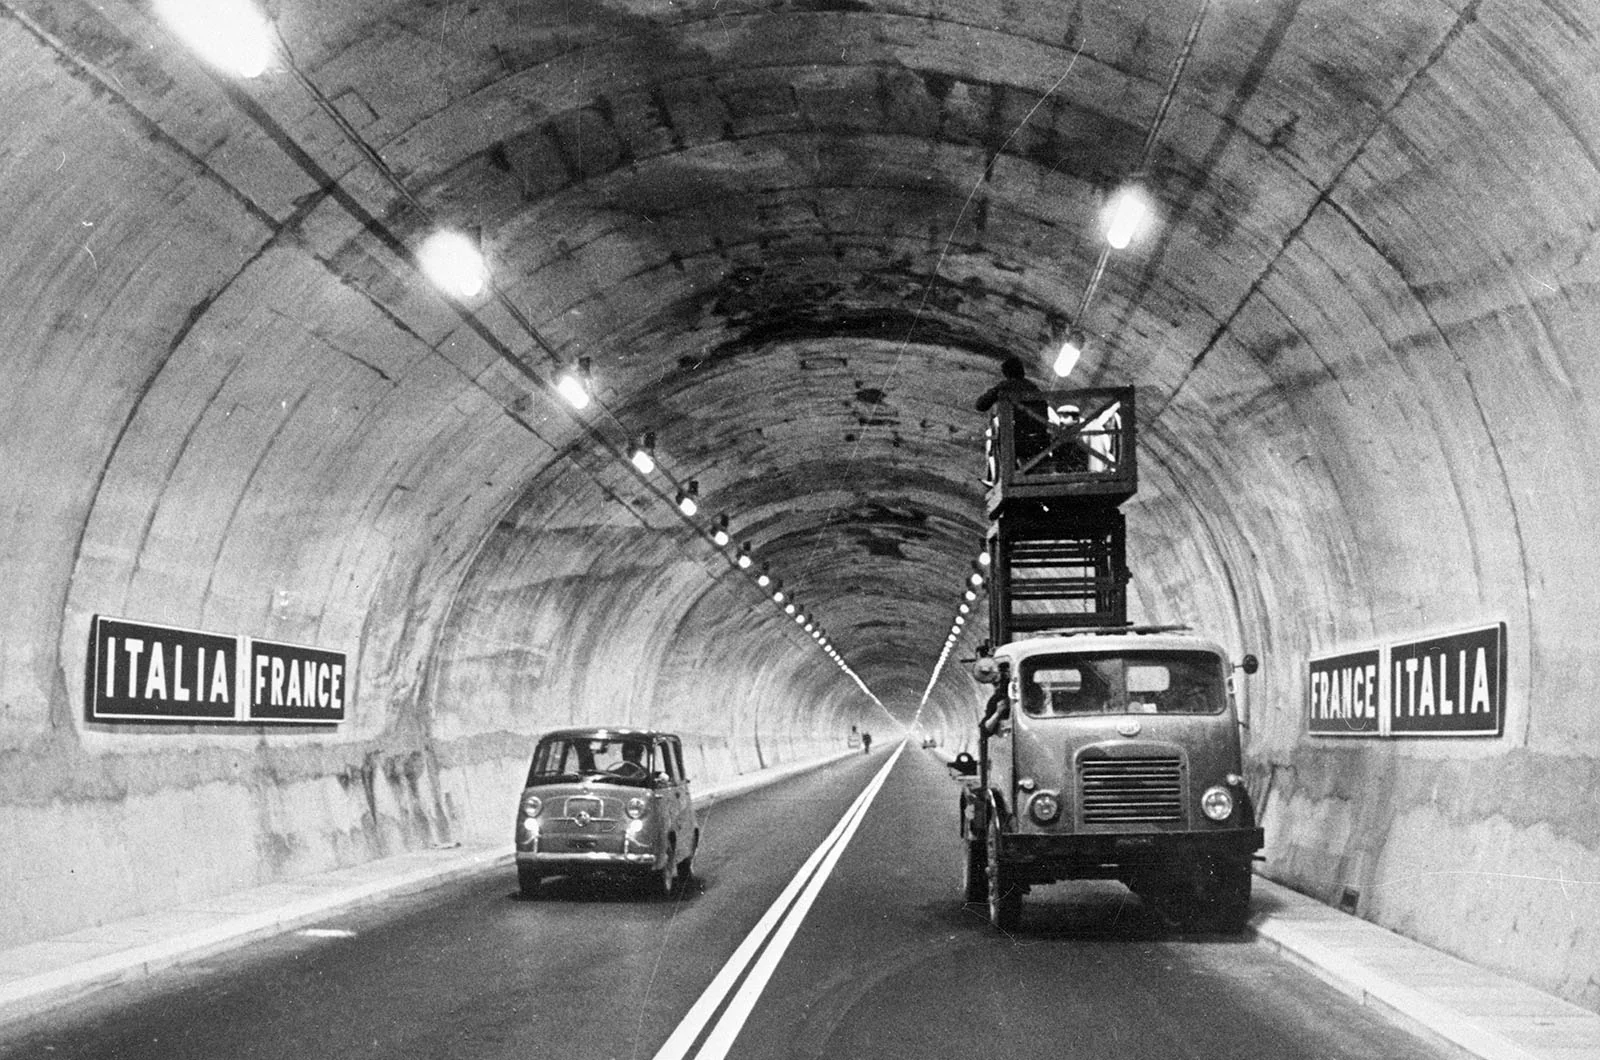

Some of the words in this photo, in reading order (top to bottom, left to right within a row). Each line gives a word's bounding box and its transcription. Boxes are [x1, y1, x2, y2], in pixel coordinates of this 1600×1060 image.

[106, 636, 229, 703] ITALIA
[255, 654, 342, 709] FRANCE
[1311, 664, 1376, 719] FRANCE
[1395, 647, 1490, 718] ITALIA
